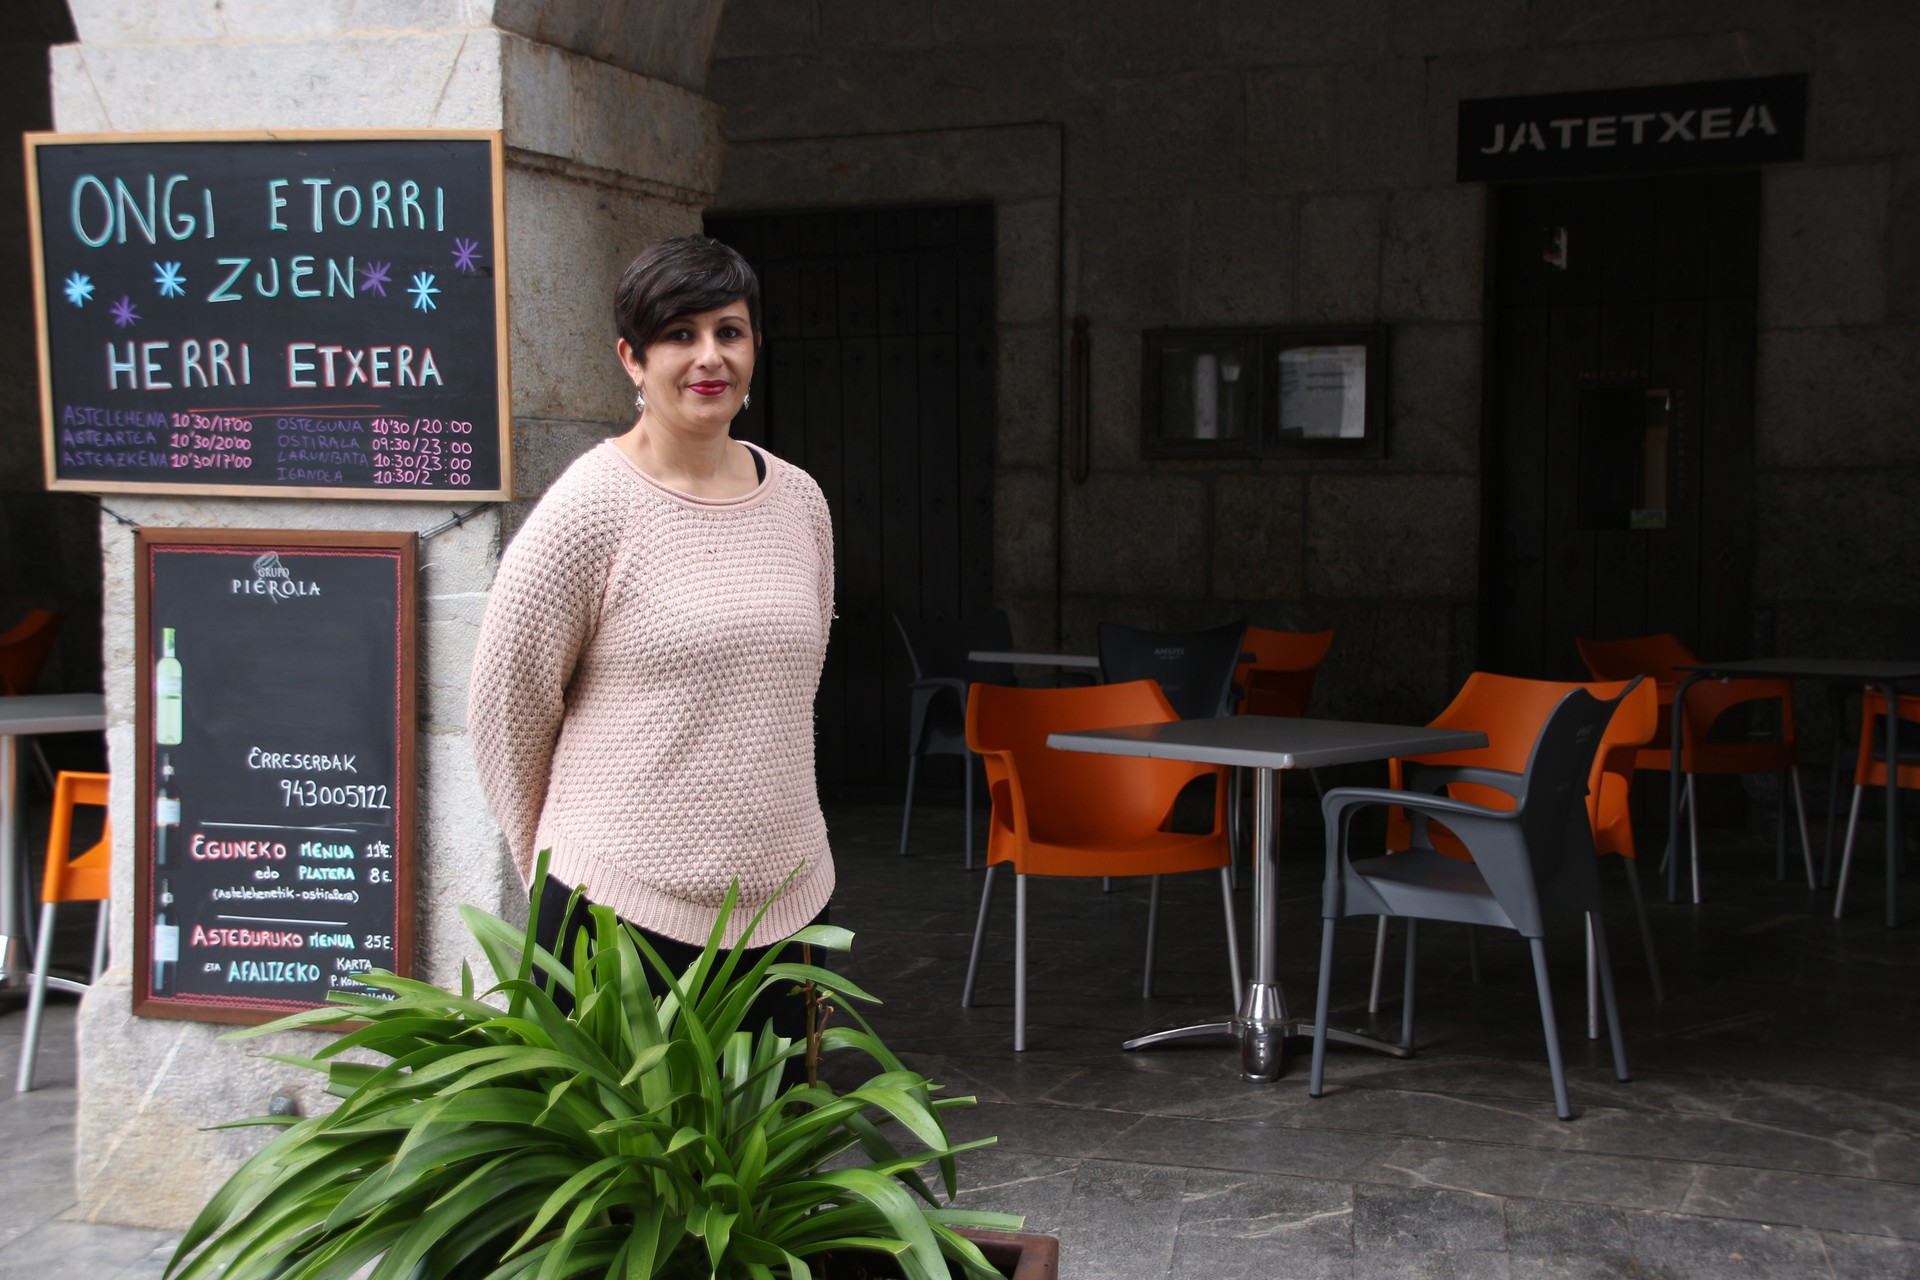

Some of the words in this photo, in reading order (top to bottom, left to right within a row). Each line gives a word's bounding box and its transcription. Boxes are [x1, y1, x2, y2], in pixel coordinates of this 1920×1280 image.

[1480, 104, 1778, 154] JATETXEA
[71, 173, 215, 248] ONGI
[269, 177, 446, 234] ETORRI
[107, 339, 251, 390] HERRI
[287, 342, 443, 388] ETXERA
[63, 405, 169, 430] ASTELEHENA
[276, 417, 364, 434] OSTEGUNA
[63, 427, 157, 449] ASTEARTEA
[277, 434, 361, 449] OSTIRALA
[63, 450, 169, 470] ASTEAZKENA
[277, 451, 369, 467] LARUNBATA
[276, 466, 343, 483] IGANDEA
[258, 567, 290, 578] GRUPO
[231, 577, 321, 599] PIÉROLA
[248, 746, 358, 774] ERRESERBAK
[280, 779, 391, 809] 943005922
[190, 833, 287, 860] EGUNEKO
[299, 841, 355, 860] MENUA
[254, 866, 280, 880] edo
[298, 864, 356, 881] PLATERA
[190, 924, 303, 948] ASTEBURUKO
[308, 932, 356, 950] MENUA
[227, 959, 321, 984] AFALTZEKO
[336, 957, 373, 972] KARTA
